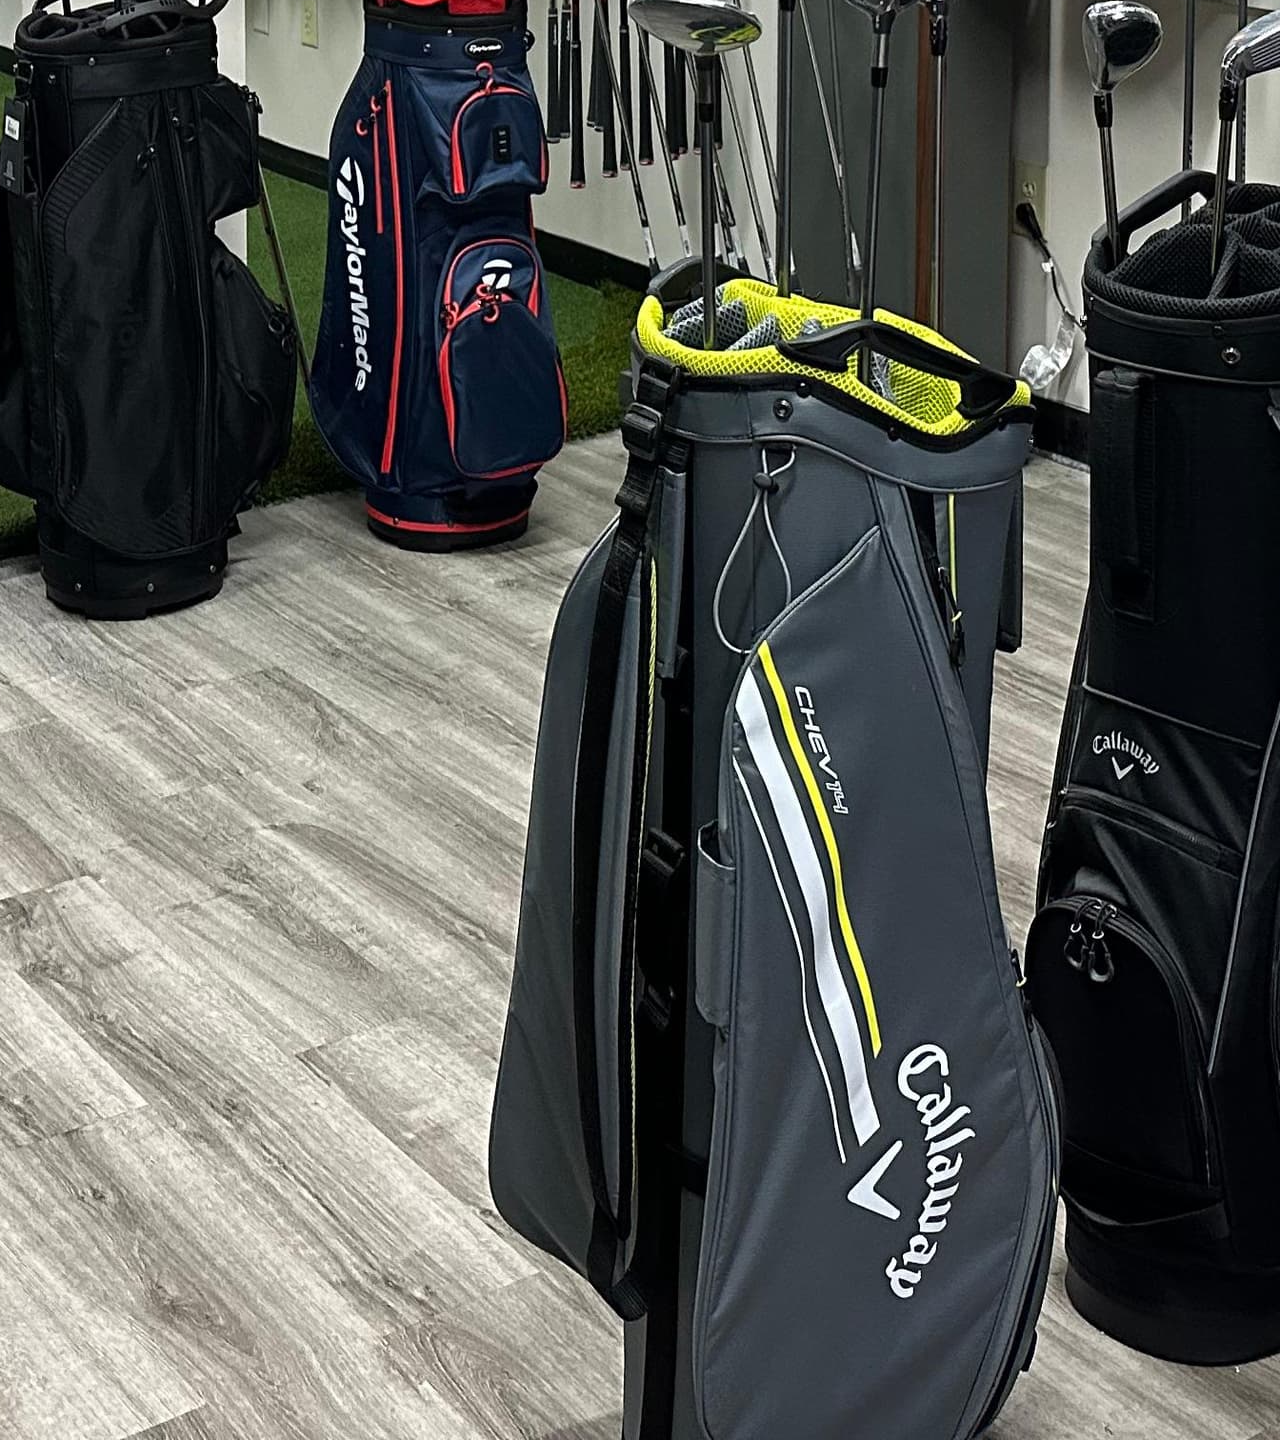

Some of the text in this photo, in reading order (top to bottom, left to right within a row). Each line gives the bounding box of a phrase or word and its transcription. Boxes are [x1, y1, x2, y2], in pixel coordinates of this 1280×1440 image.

[336, 157, 372, 392] TaylorMade
[1092, 730, 1160, 775] Callaway
[884, 1042, 977, 1300] Callaway
